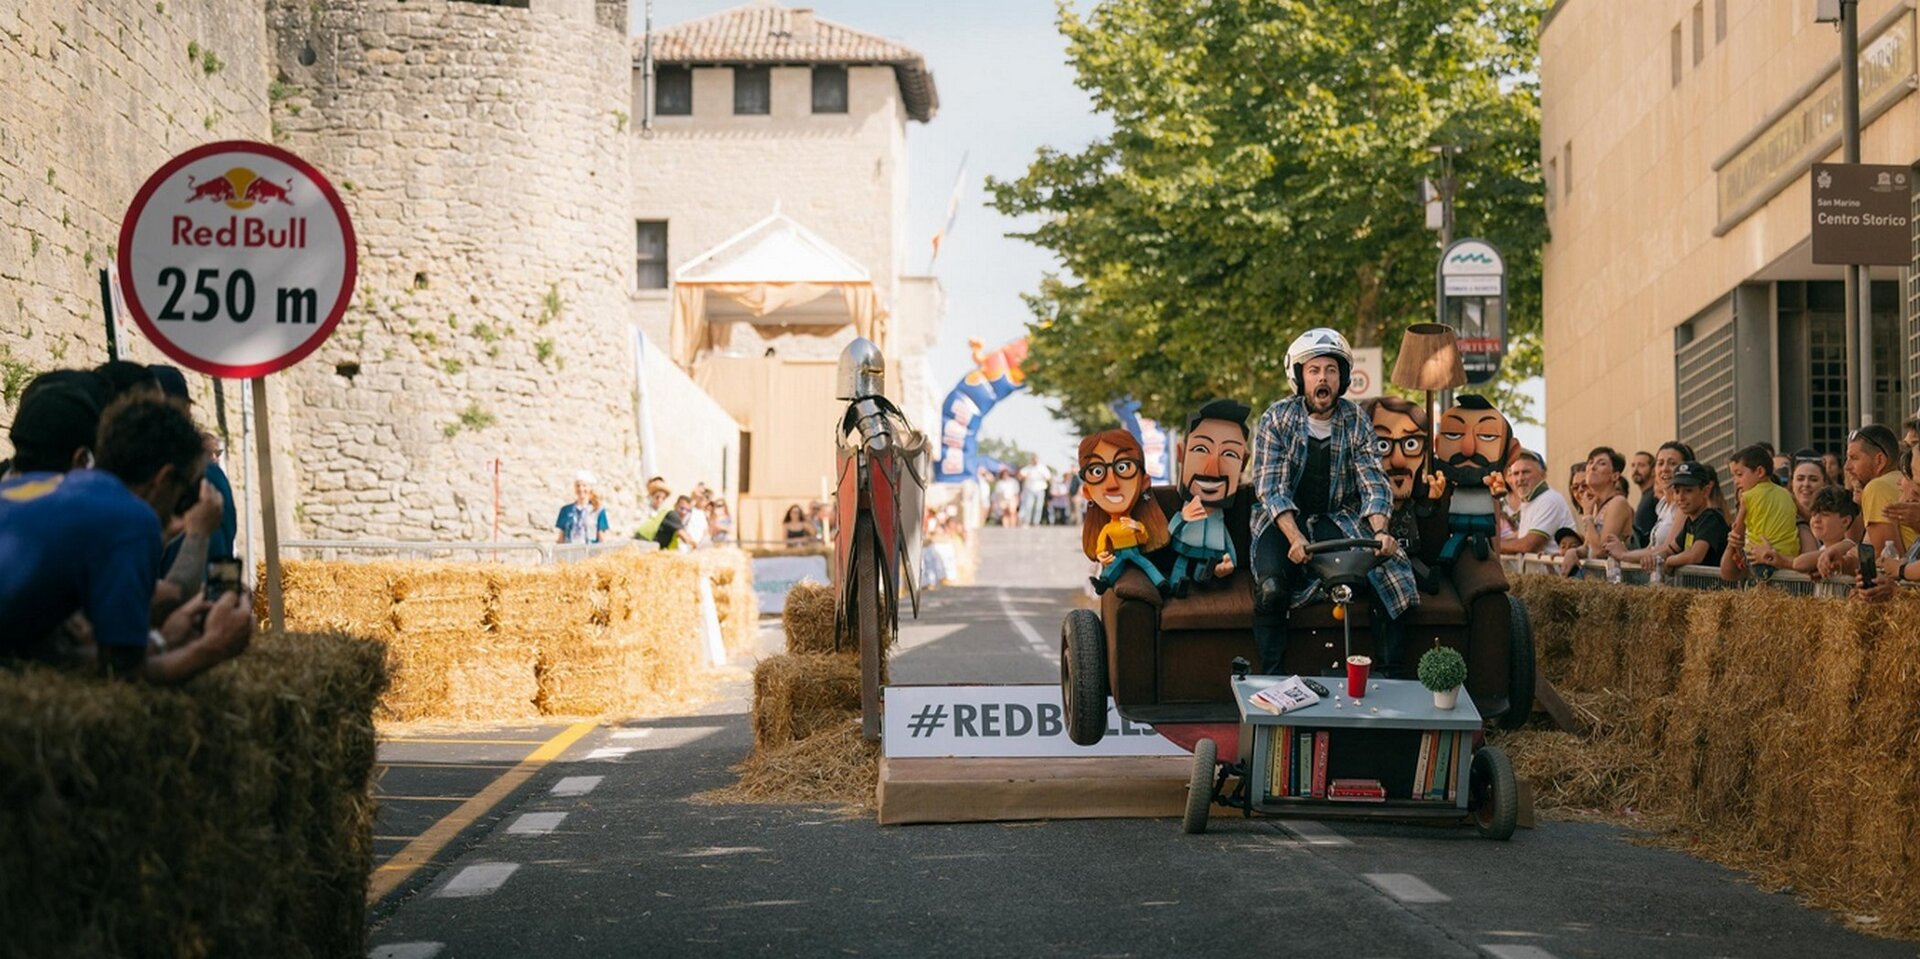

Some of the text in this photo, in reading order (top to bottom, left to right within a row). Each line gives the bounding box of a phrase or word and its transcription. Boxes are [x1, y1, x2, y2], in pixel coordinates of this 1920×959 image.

[1817, 198, 1861, 207] San Marino
[1818, 212, 1906, 226] Centro Storico
[172, 215, 307, 248] Red Bull
[157, 267, 256, 323] 250
[276, 287, 318, 324] m
